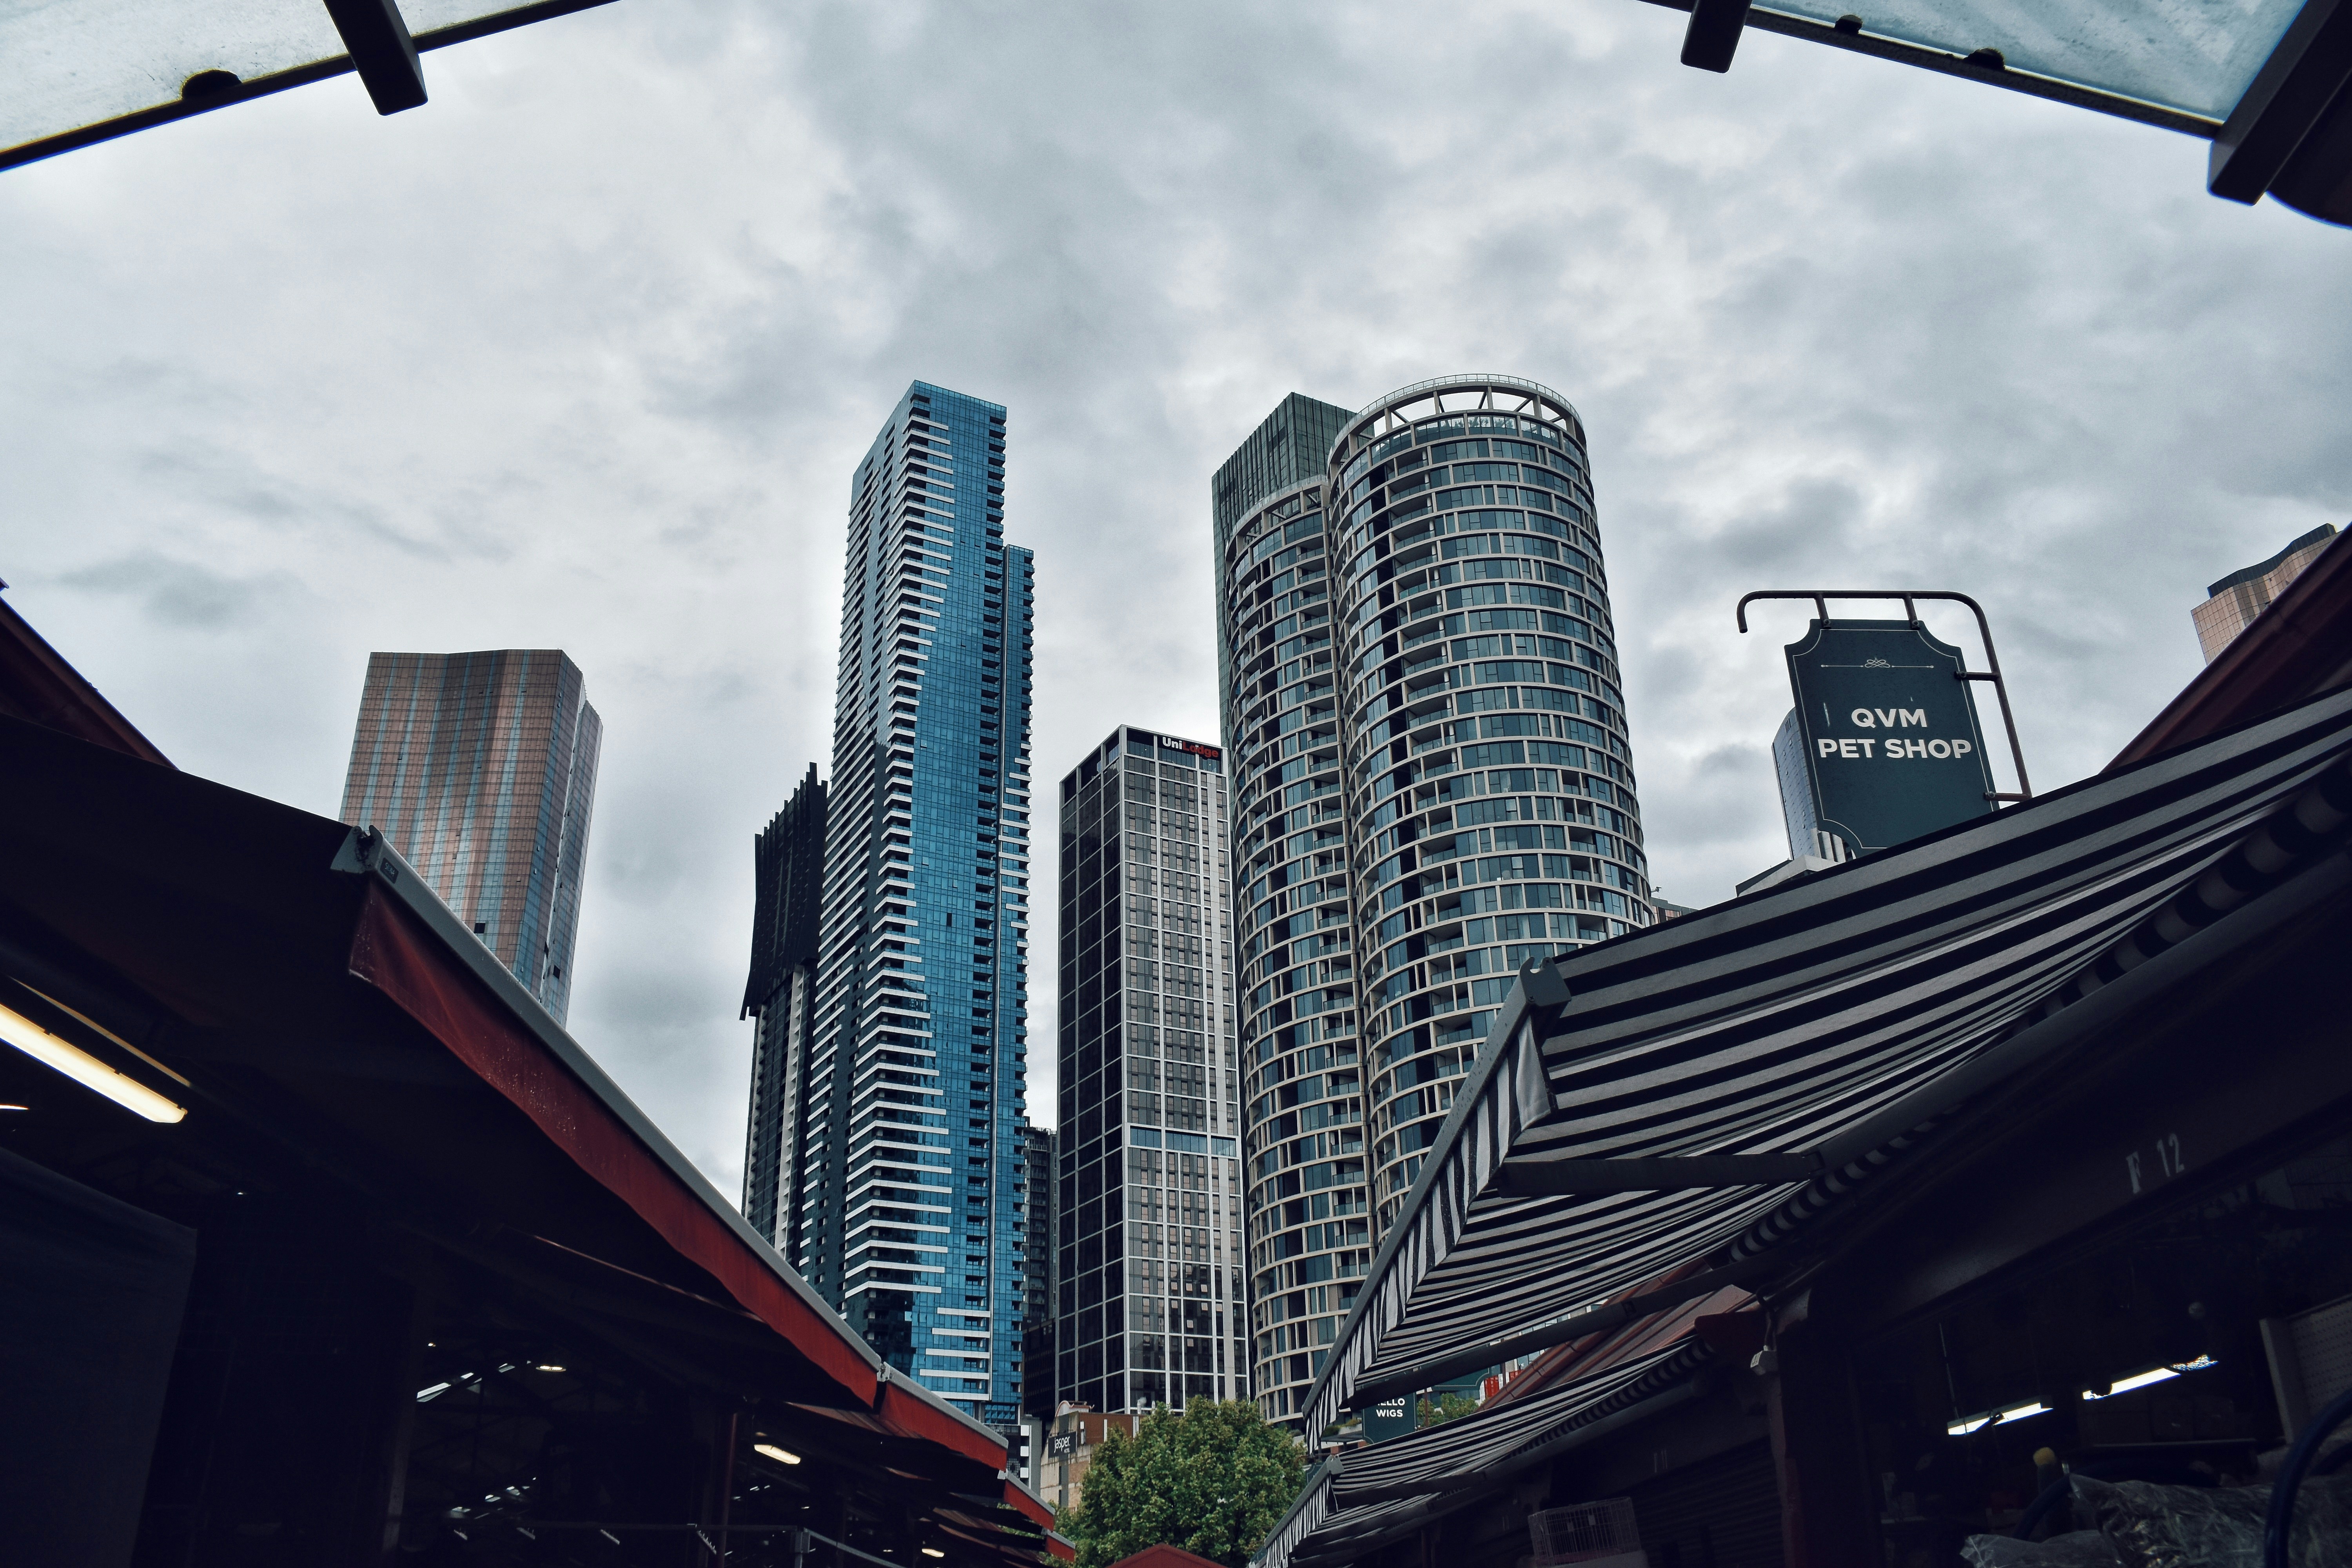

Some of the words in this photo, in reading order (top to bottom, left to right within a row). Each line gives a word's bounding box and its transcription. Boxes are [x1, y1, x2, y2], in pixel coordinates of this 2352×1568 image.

[1851, 708, 1927, 728] QVM
[1162, 736, 1219, 758] UniLodge
[1817, 739, 1876, 758] PET
[1884, 739, 1972, 759] SHOP
[2125, 1151, 2141, 1194] F
[2156, 1133, 2185, 1177] 12
